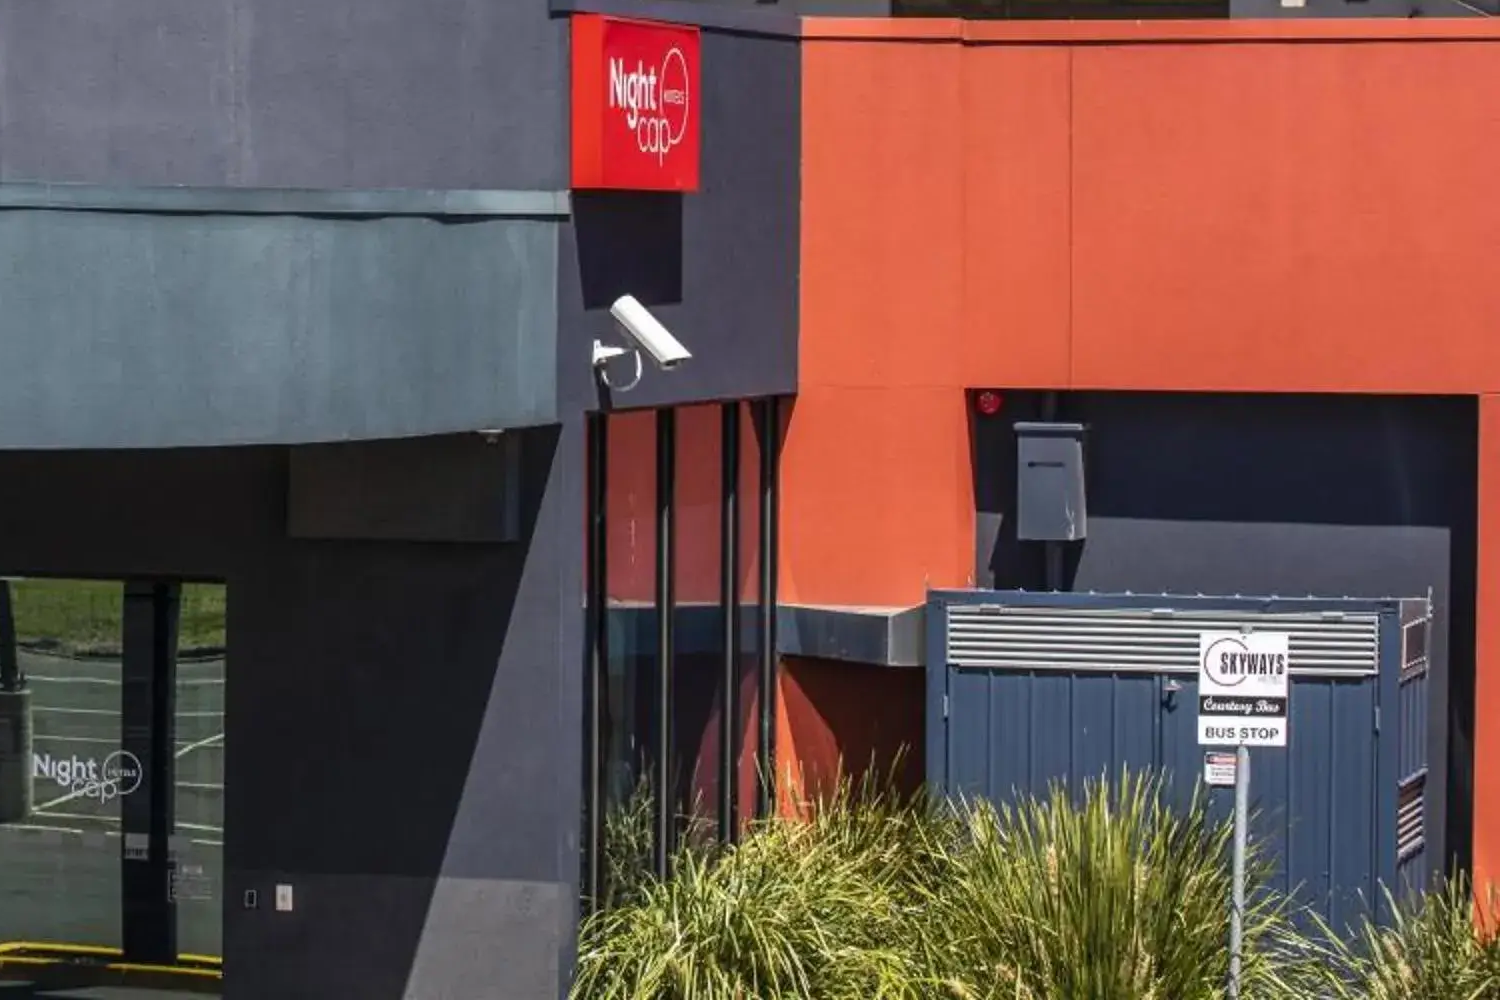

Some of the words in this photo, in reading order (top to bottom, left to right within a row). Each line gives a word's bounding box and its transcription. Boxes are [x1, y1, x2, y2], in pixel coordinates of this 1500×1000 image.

[609, 56, 658, 129] Night
[638, 117, 671, 168] cap
[1220, 651, 1285, 676] SKYWAYS
[1205, 727, 1236, 739] BUS
[1239, 727, 1279, 739] STOP
[32, 753, 97, 785] Night
[71, 778, 118, 804] cap
